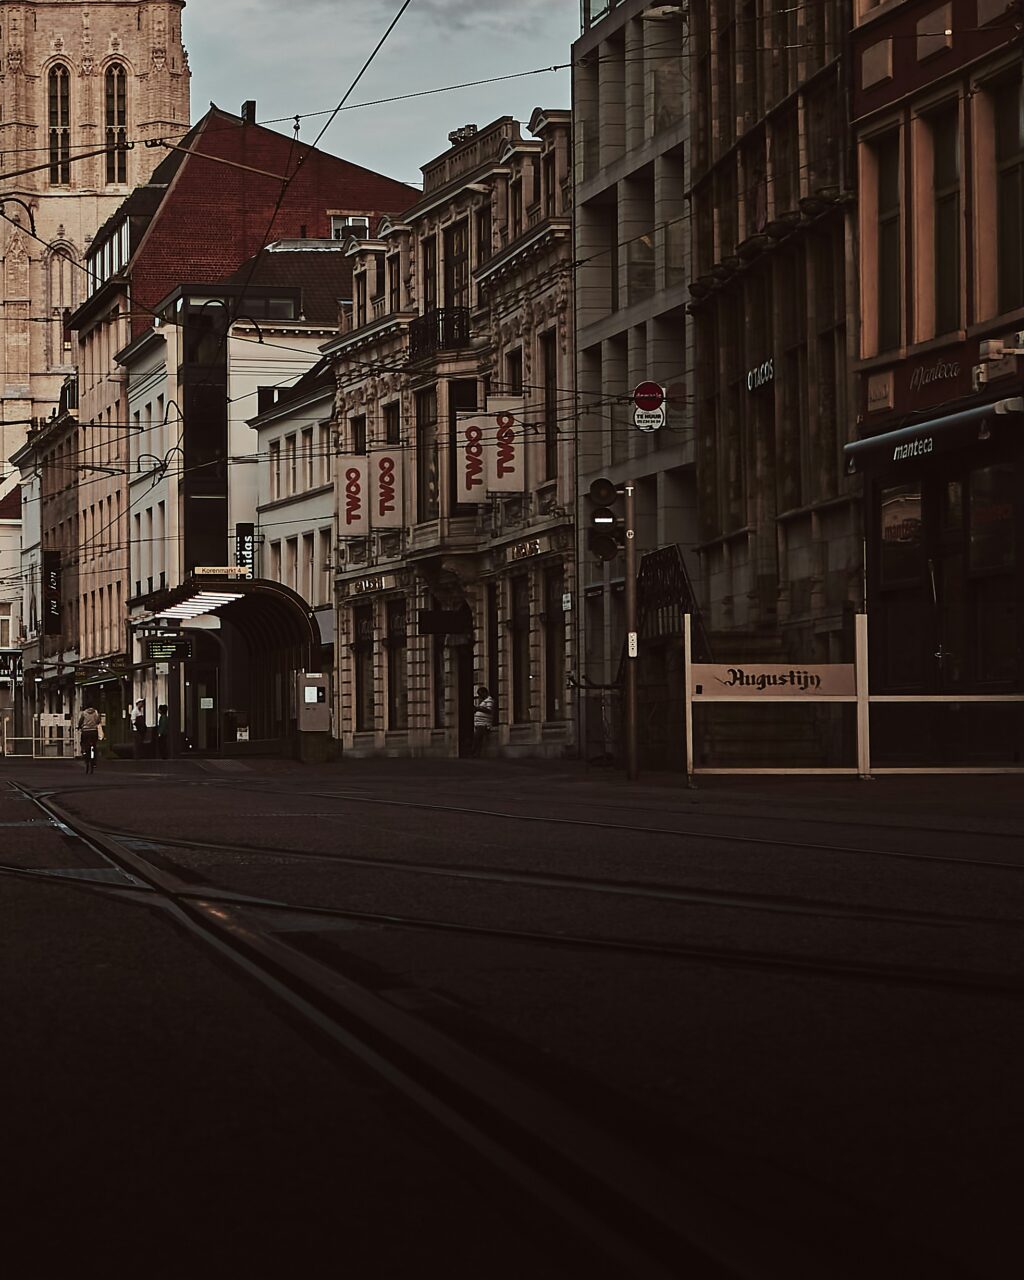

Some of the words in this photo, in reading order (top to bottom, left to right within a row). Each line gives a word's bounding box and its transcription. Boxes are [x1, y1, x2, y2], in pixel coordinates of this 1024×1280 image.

[909, 358, 961, 391] Manteca
[464, 426, 483, 490] TWOO
[496, 411, 515, 479] TWOO
[893, 437, 933, 461] manteca
[345, 468, 362, 525] TWOO
[378, 457, 395, 517] TWOO
[725, 668, 822, 690] Augustijn
